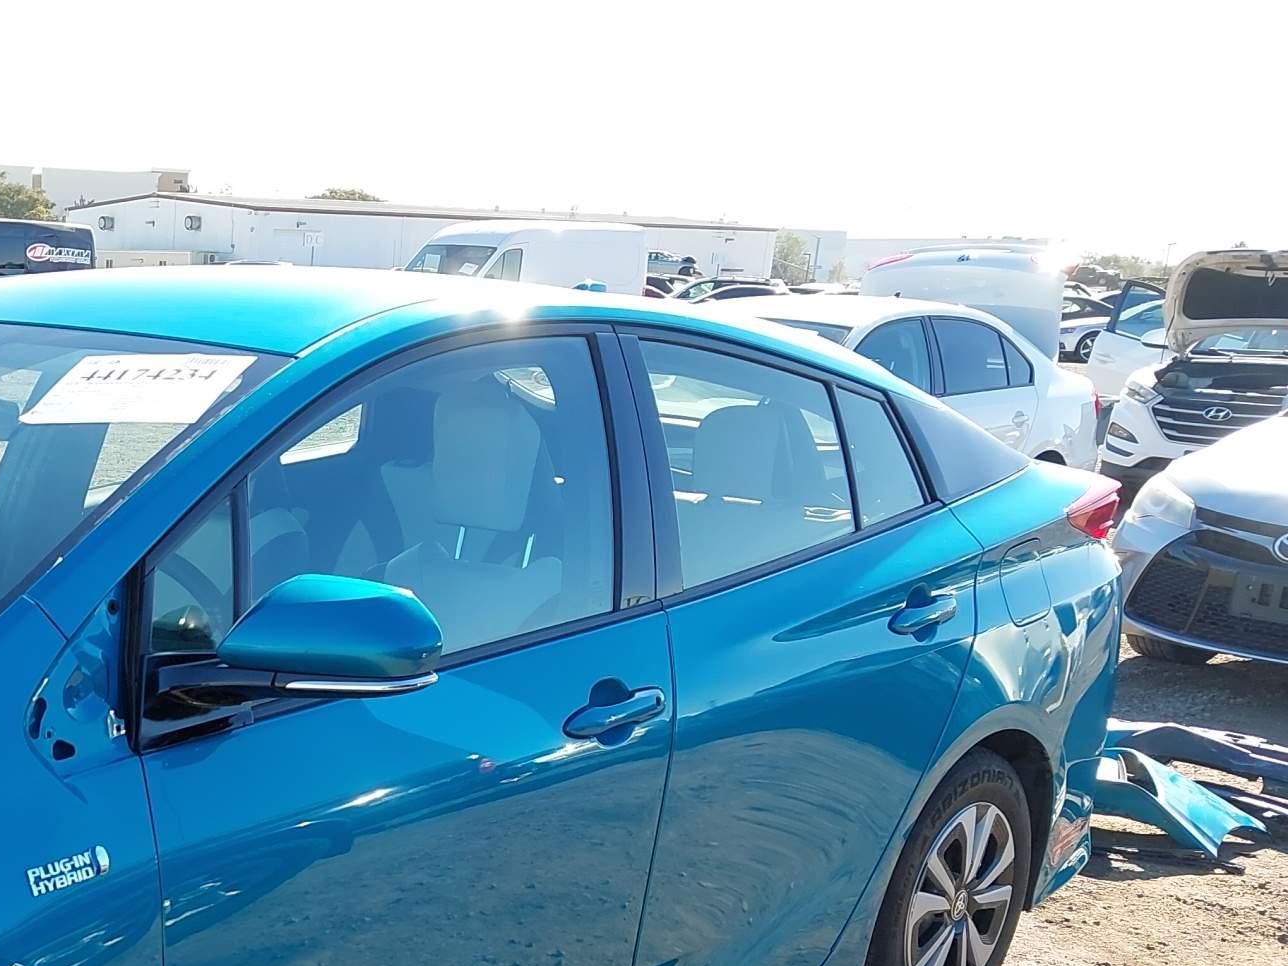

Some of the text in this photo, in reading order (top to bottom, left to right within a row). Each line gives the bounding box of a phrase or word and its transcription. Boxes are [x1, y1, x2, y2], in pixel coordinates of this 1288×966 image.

[80, 368, 219, 382] 44174234
[27, 850, 91, 885] PLUG-IN
[32, 866, 96, 897] HYBRID
